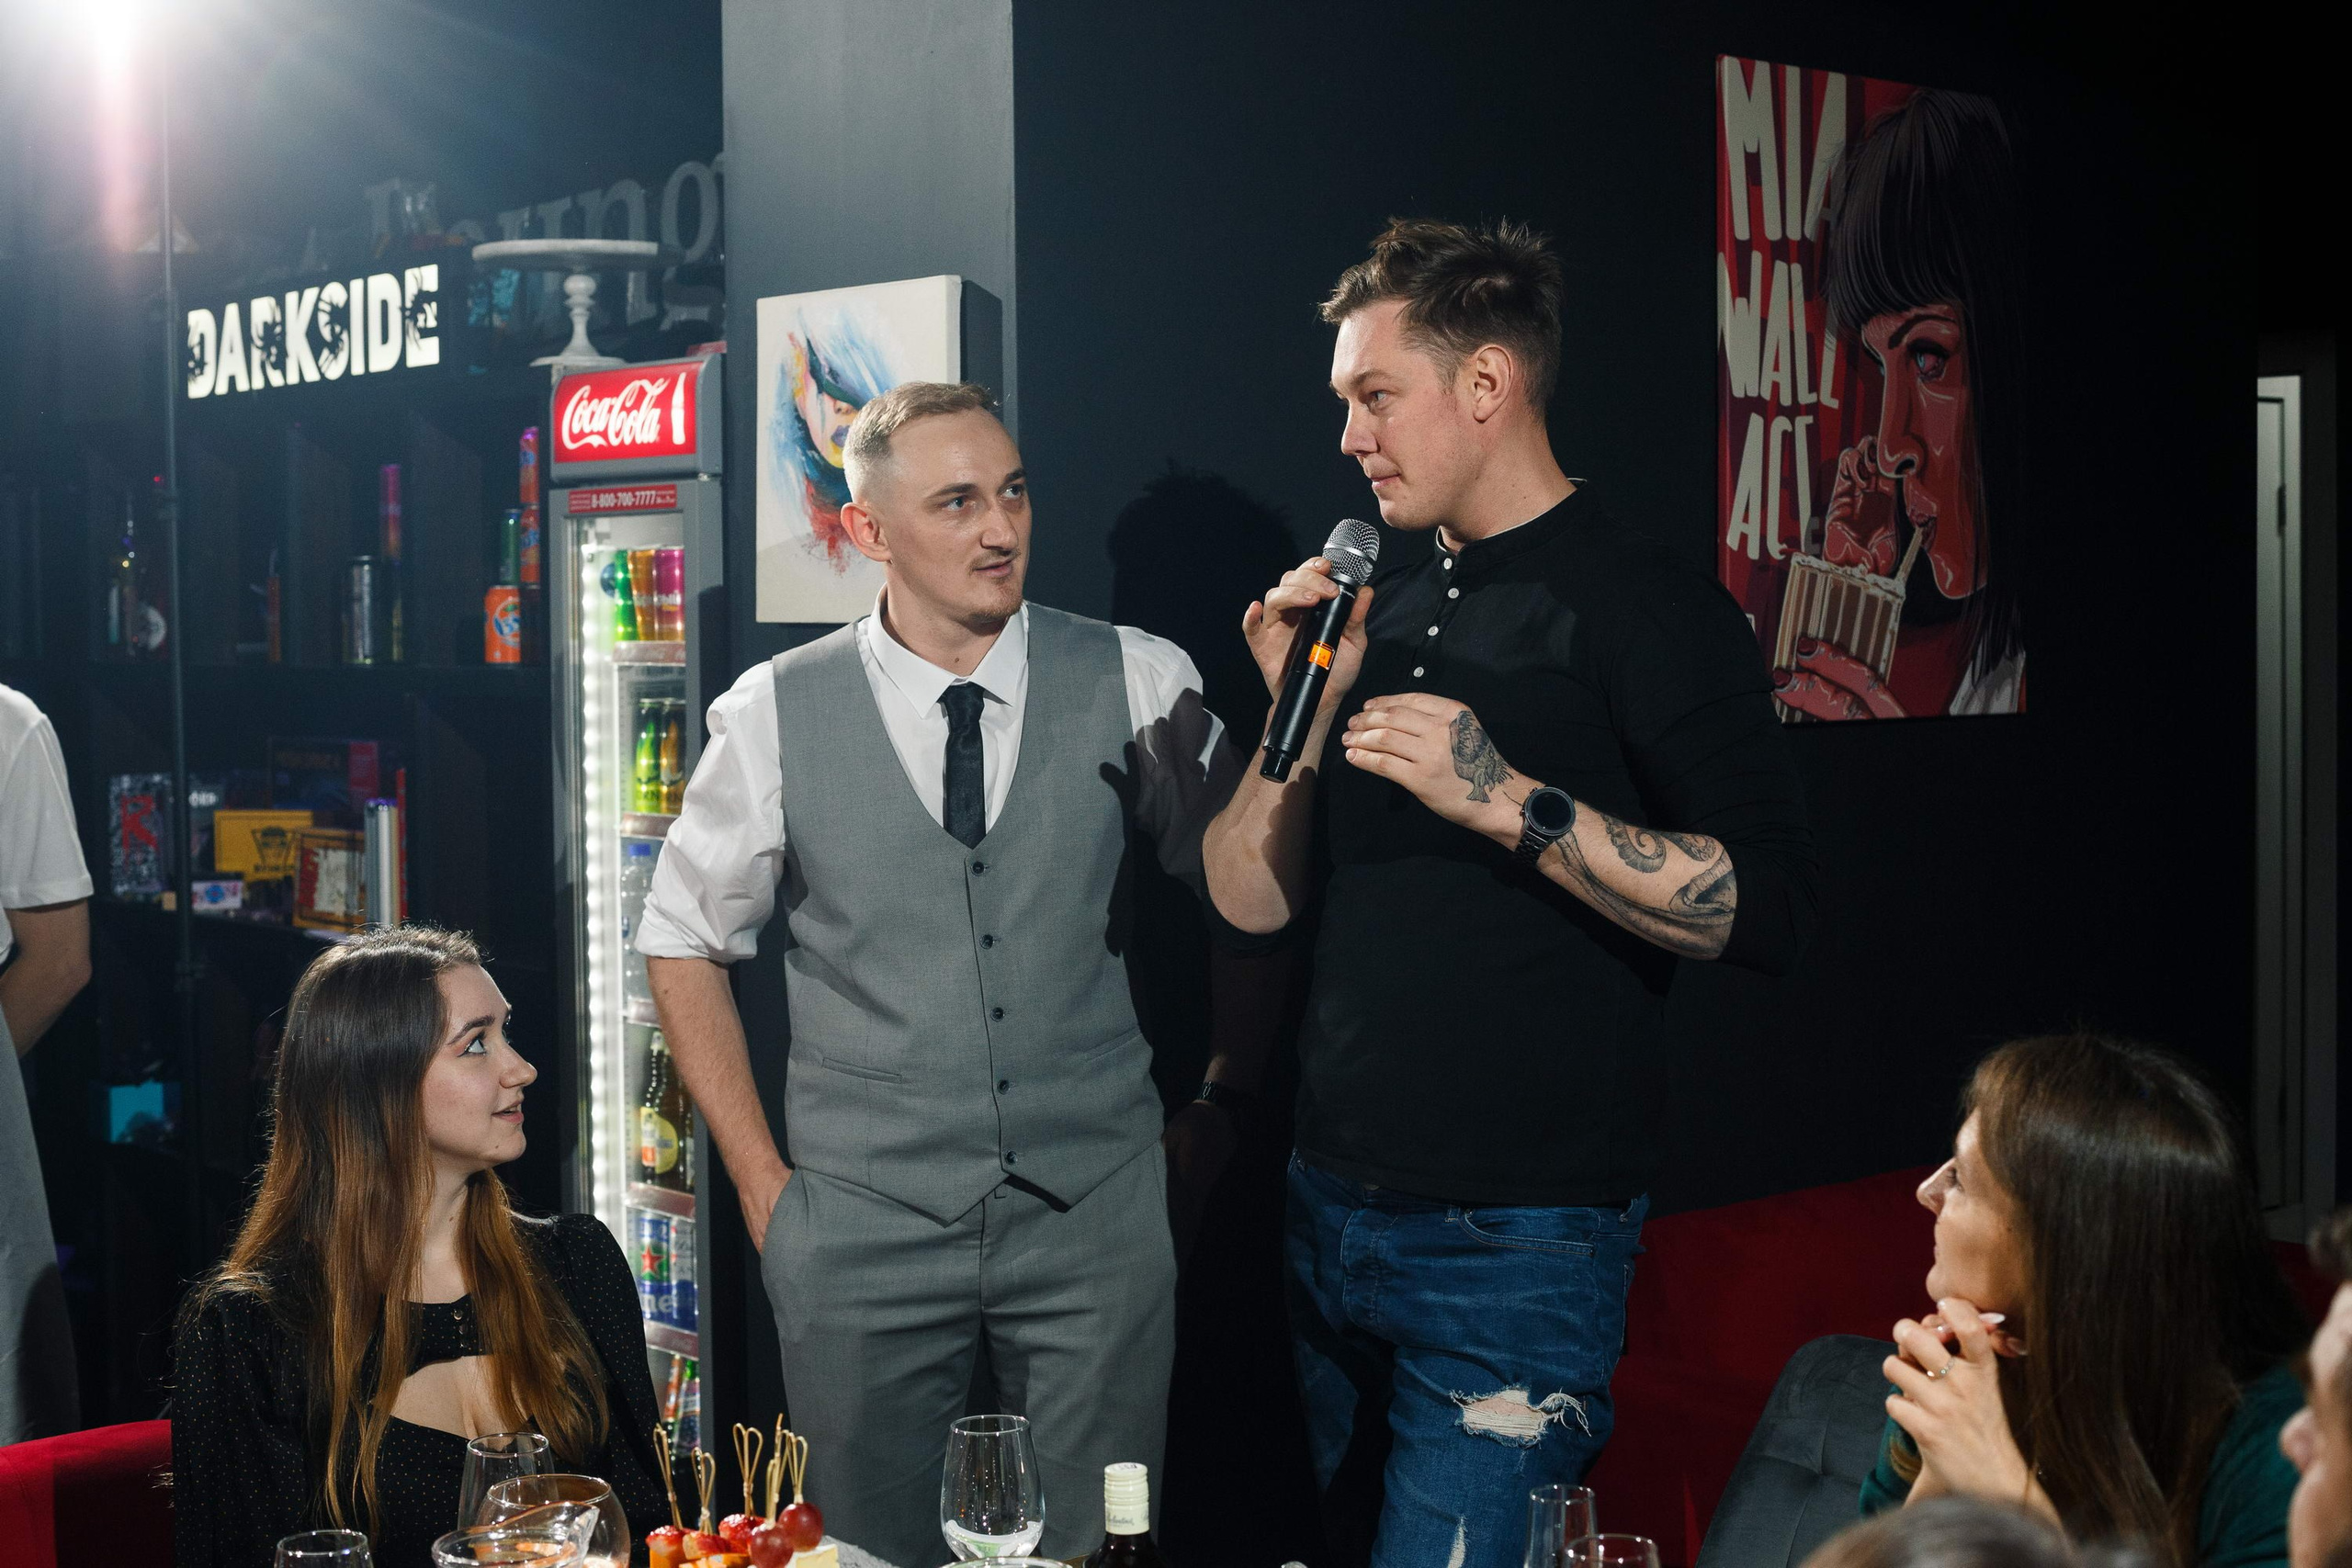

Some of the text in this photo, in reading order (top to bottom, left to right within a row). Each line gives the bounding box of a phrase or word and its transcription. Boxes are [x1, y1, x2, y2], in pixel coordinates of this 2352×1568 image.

[1723, 56, 1847, 243] MIA
[188, 264, 439, 399] DARKSIDE
[1716, 250, 1839, 410] WALL
[561, 377, 672, 450] Coca-Cola
[591, 490, 657, 509] 8-800-700-7777
